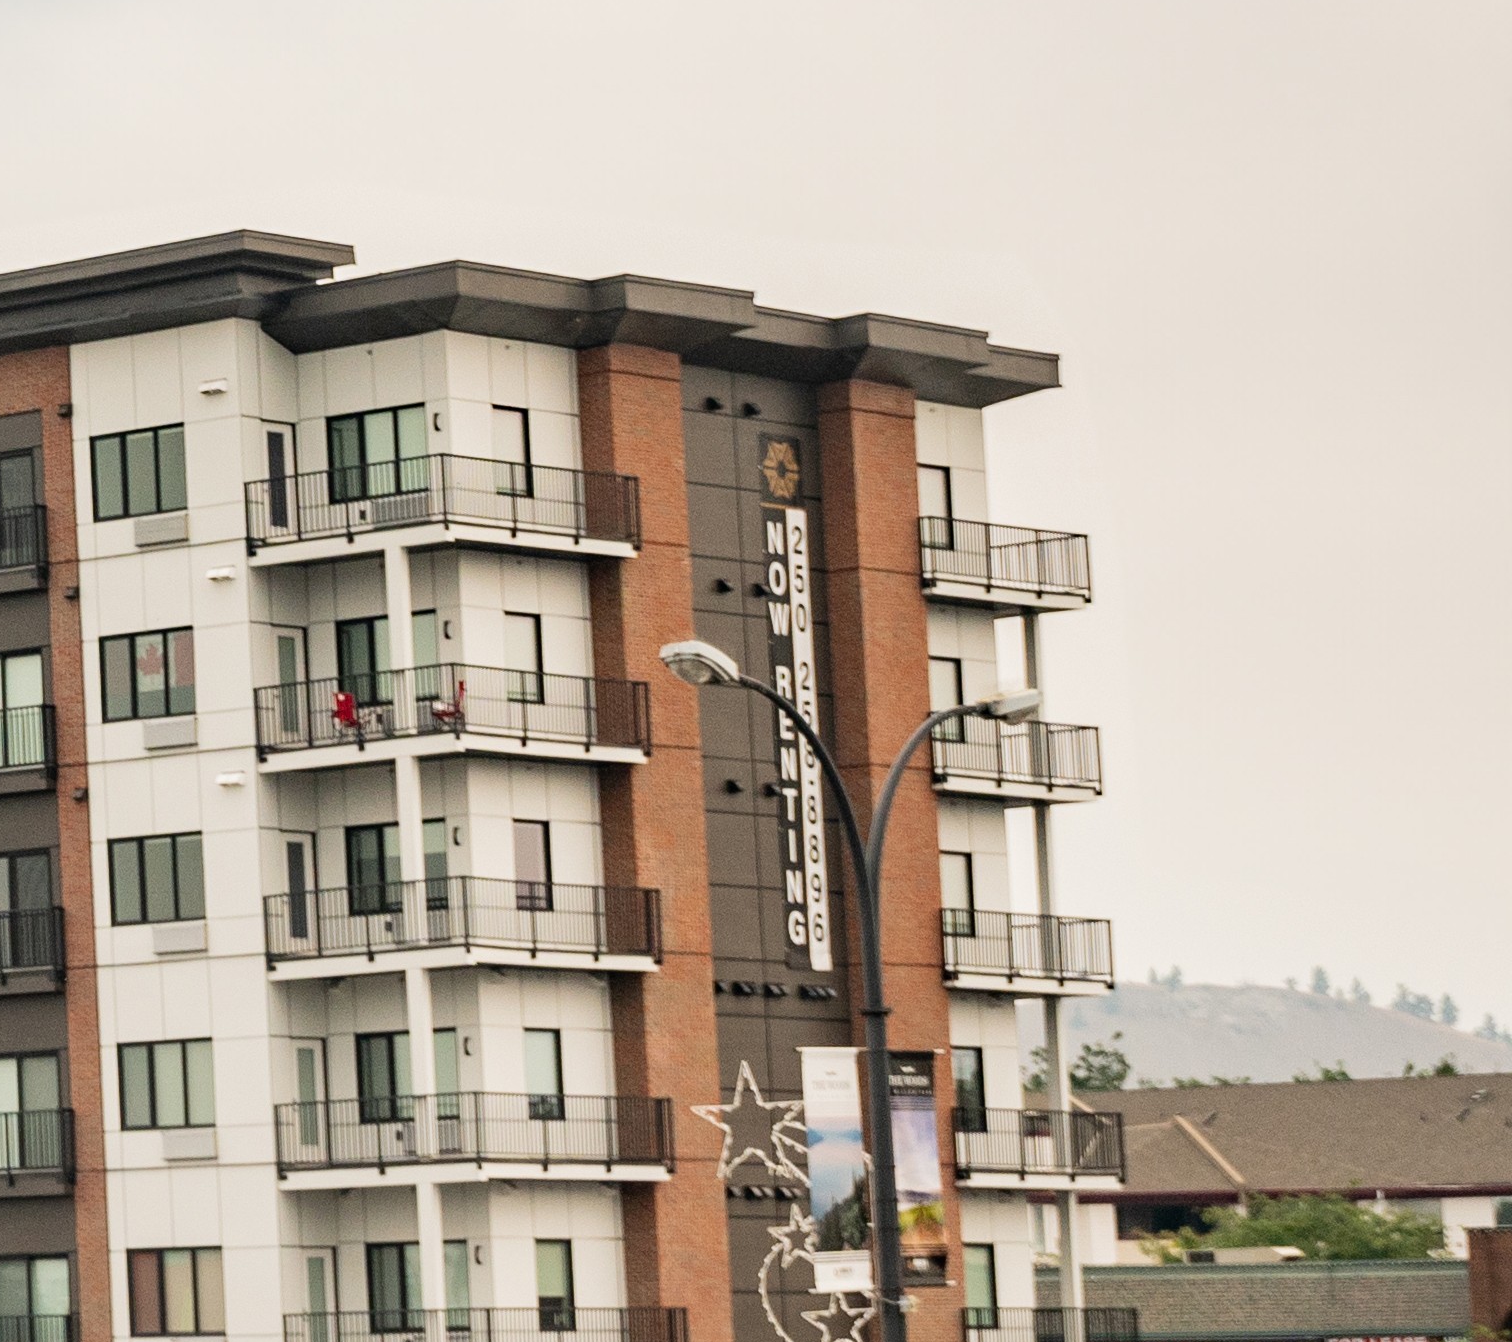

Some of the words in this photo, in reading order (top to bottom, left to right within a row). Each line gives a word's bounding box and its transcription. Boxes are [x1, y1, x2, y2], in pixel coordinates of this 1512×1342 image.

[766, 520, 791, 637] NOW
[791, 525, 807, 633] 250
[775, 665, 807, 946] RENTING
